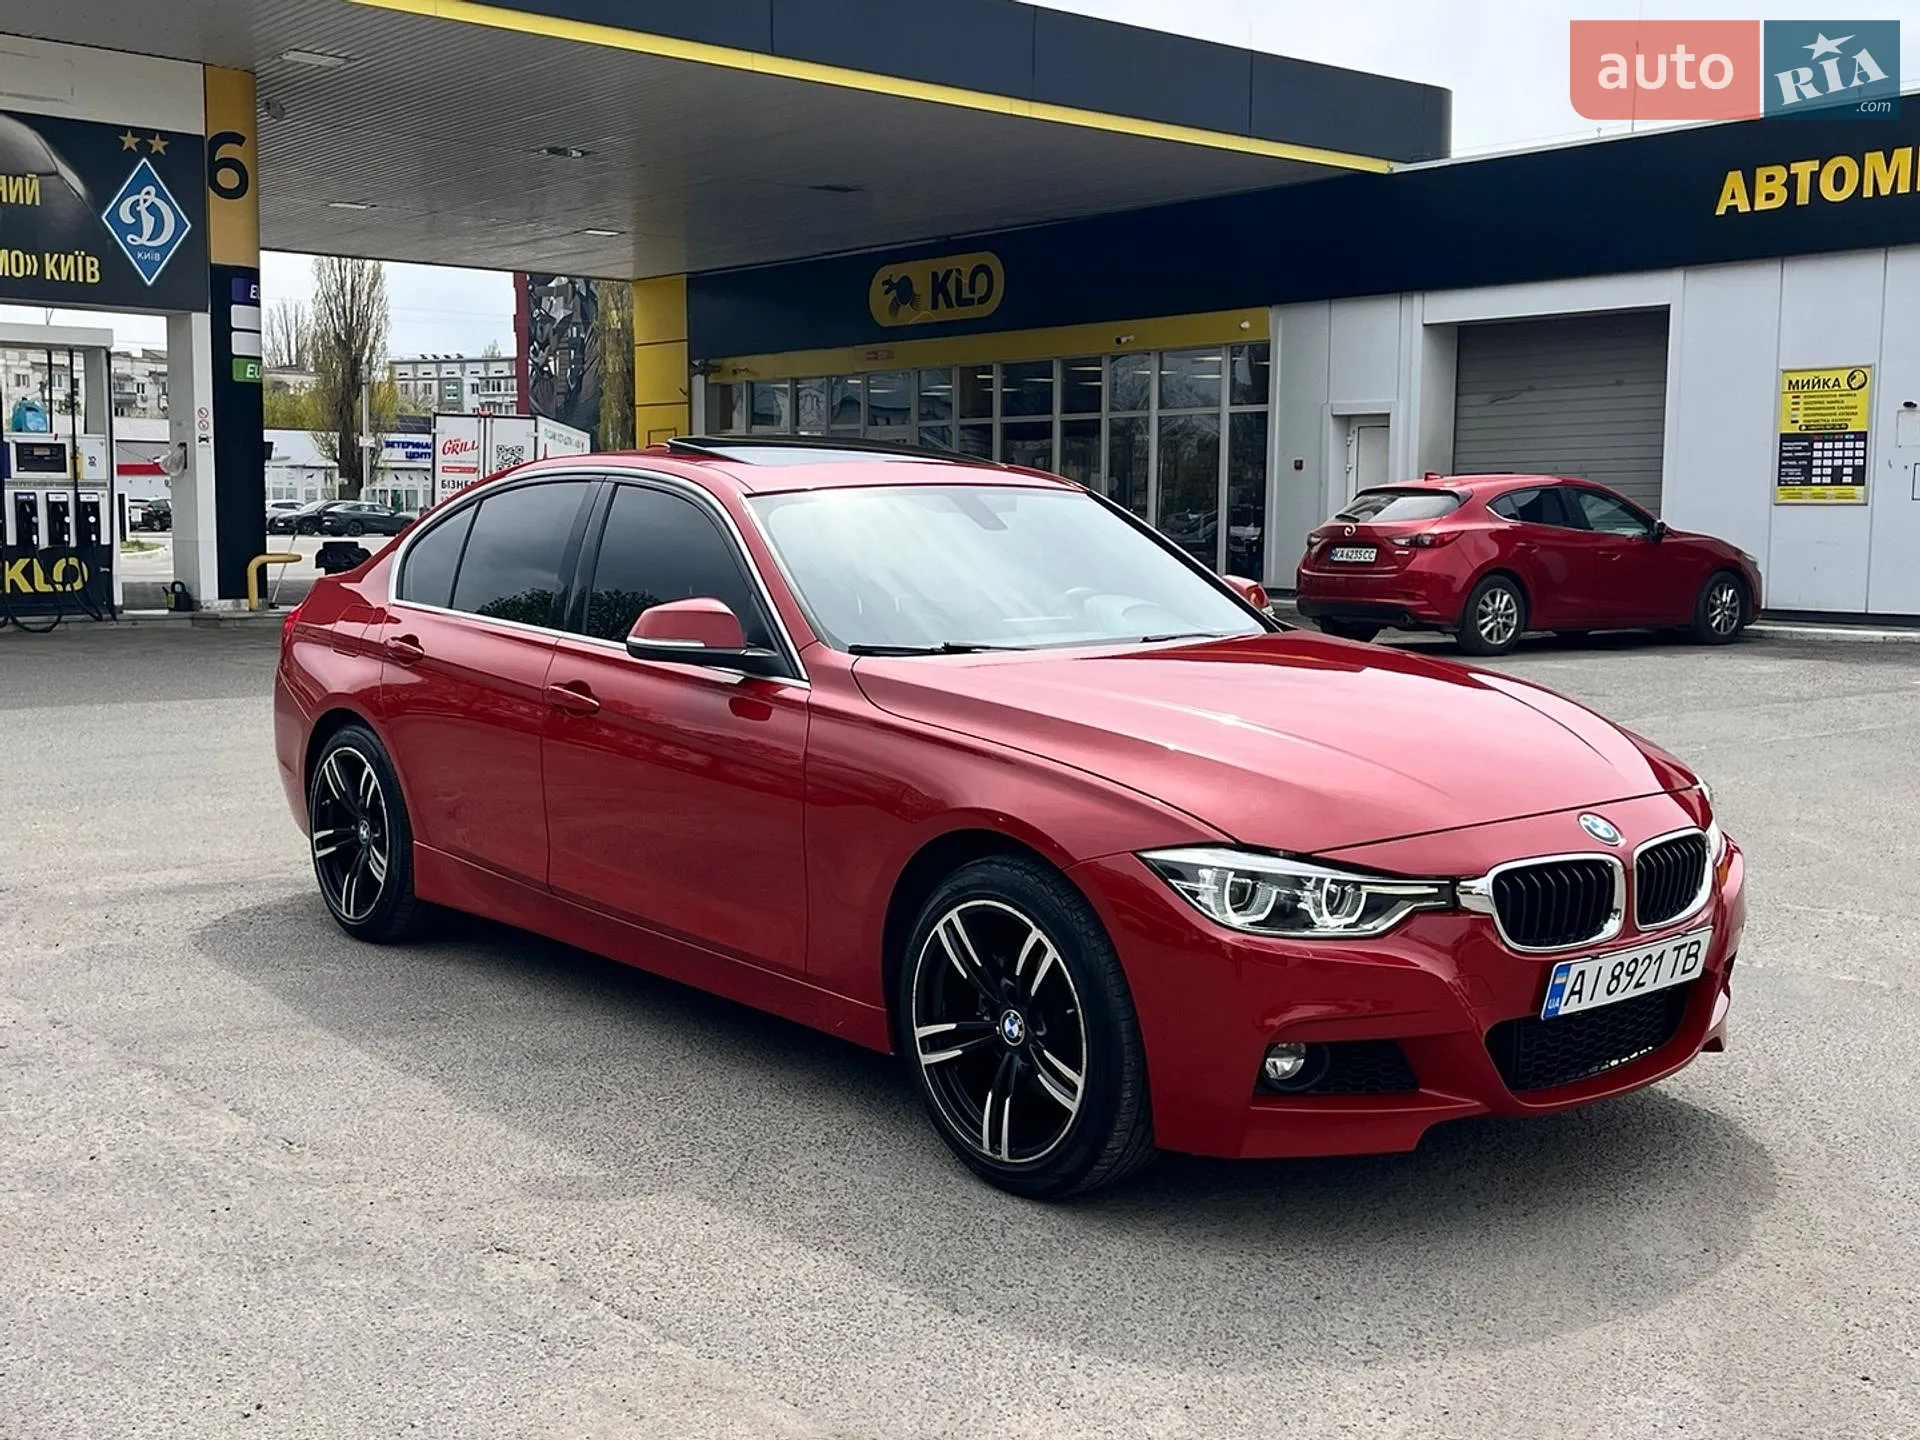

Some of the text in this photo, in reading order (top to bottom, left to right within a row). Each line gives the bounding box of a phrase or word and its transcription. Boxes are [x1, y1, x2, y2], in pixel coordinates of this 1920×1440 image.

[207, 131, 248, 200] 6
[1715, 146, 1920, 215] АВТОМ
[45, 250, 100, 284] КИЇВ
[931, 263, 994, 310] KLO
[1788, 376, 1842, 391] МИЙКА
[441, 437, 480, 456] GRILL
[4, 557, 89, 594] KLO
[1563, 939, 1702, 1007] AI 8921 TB
